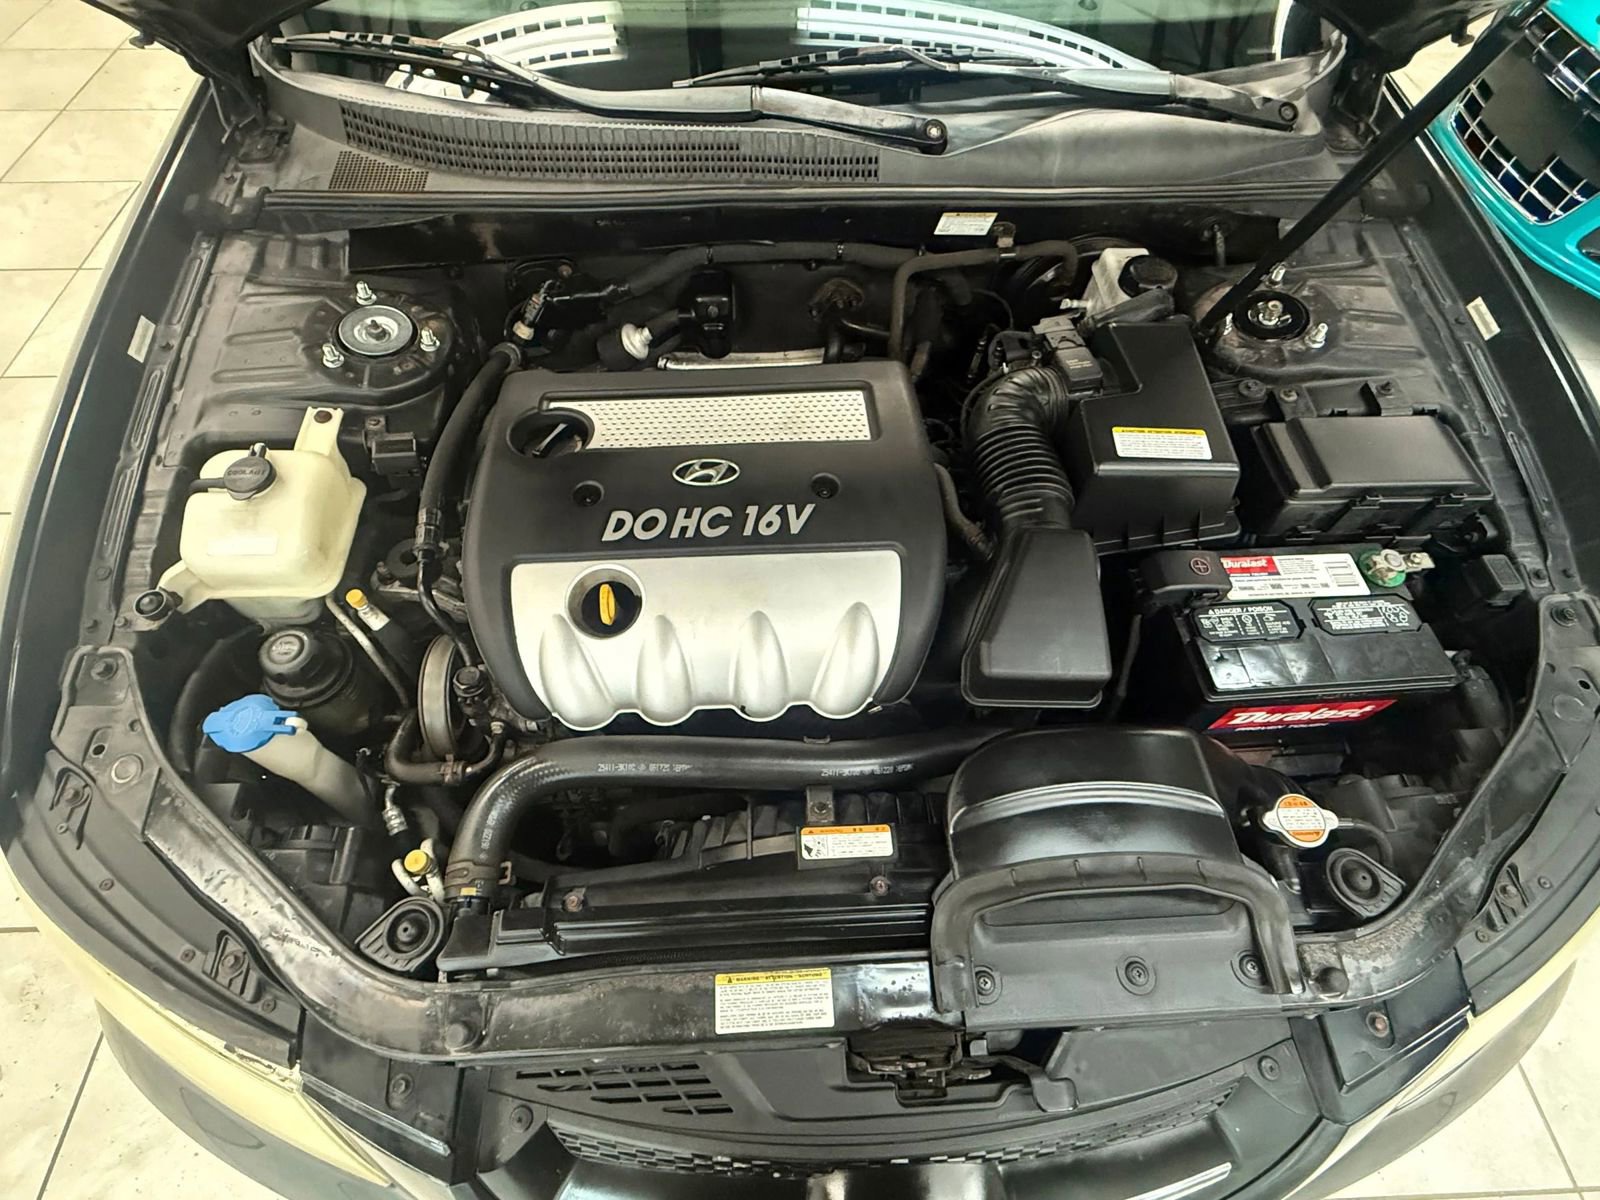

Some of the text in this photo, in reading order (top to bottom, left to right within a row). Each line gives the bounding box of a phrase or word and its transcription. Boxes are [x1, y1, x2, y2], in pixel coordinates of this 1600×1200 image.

[601, 503, 816, 542] DOHC 16V
[1222, 558, 1268, 568] Duralast
[1227, 705, 1376, 725] Duralast
